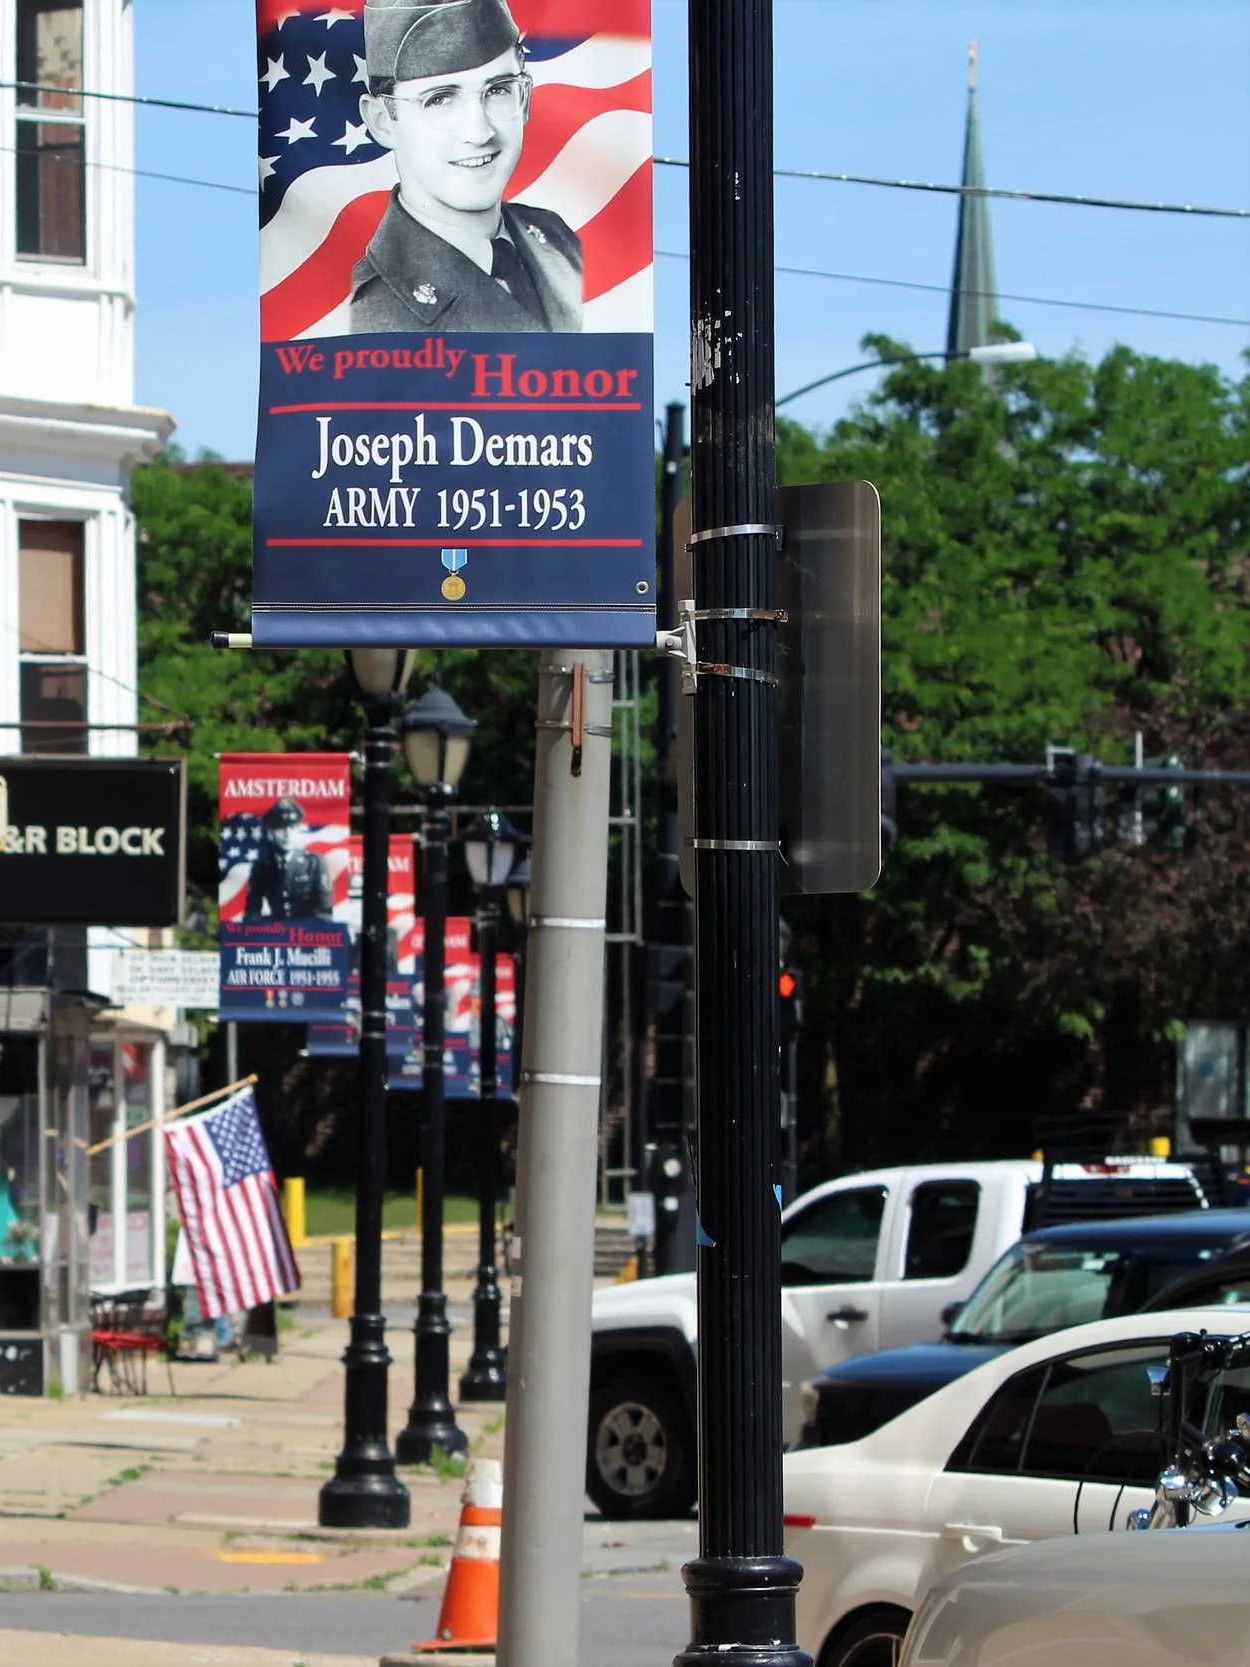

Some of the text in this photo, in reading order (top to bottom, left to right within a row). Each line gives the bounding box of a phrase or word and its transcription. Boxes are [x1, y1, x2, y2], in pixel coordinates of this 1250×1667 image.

[275, 338, 638, 397] We proudly Honor
[312, 413, 593, 483] Joseph Demars
[323, 487, 586, 530] ARMY 1951-1953
[223, 778, 346, 799] AMSTERDAM
[5, 825, 165, 856] &R BLOCK
[245, 921, 287, 936] proudly
[289, 927, 343, 943] Honor
[236, 946, 272, 966] Frank
[273, 946, 285, 970] J.
[227, 969, 248, 986] AIR
[249, 969, 285, 986] FORCE
